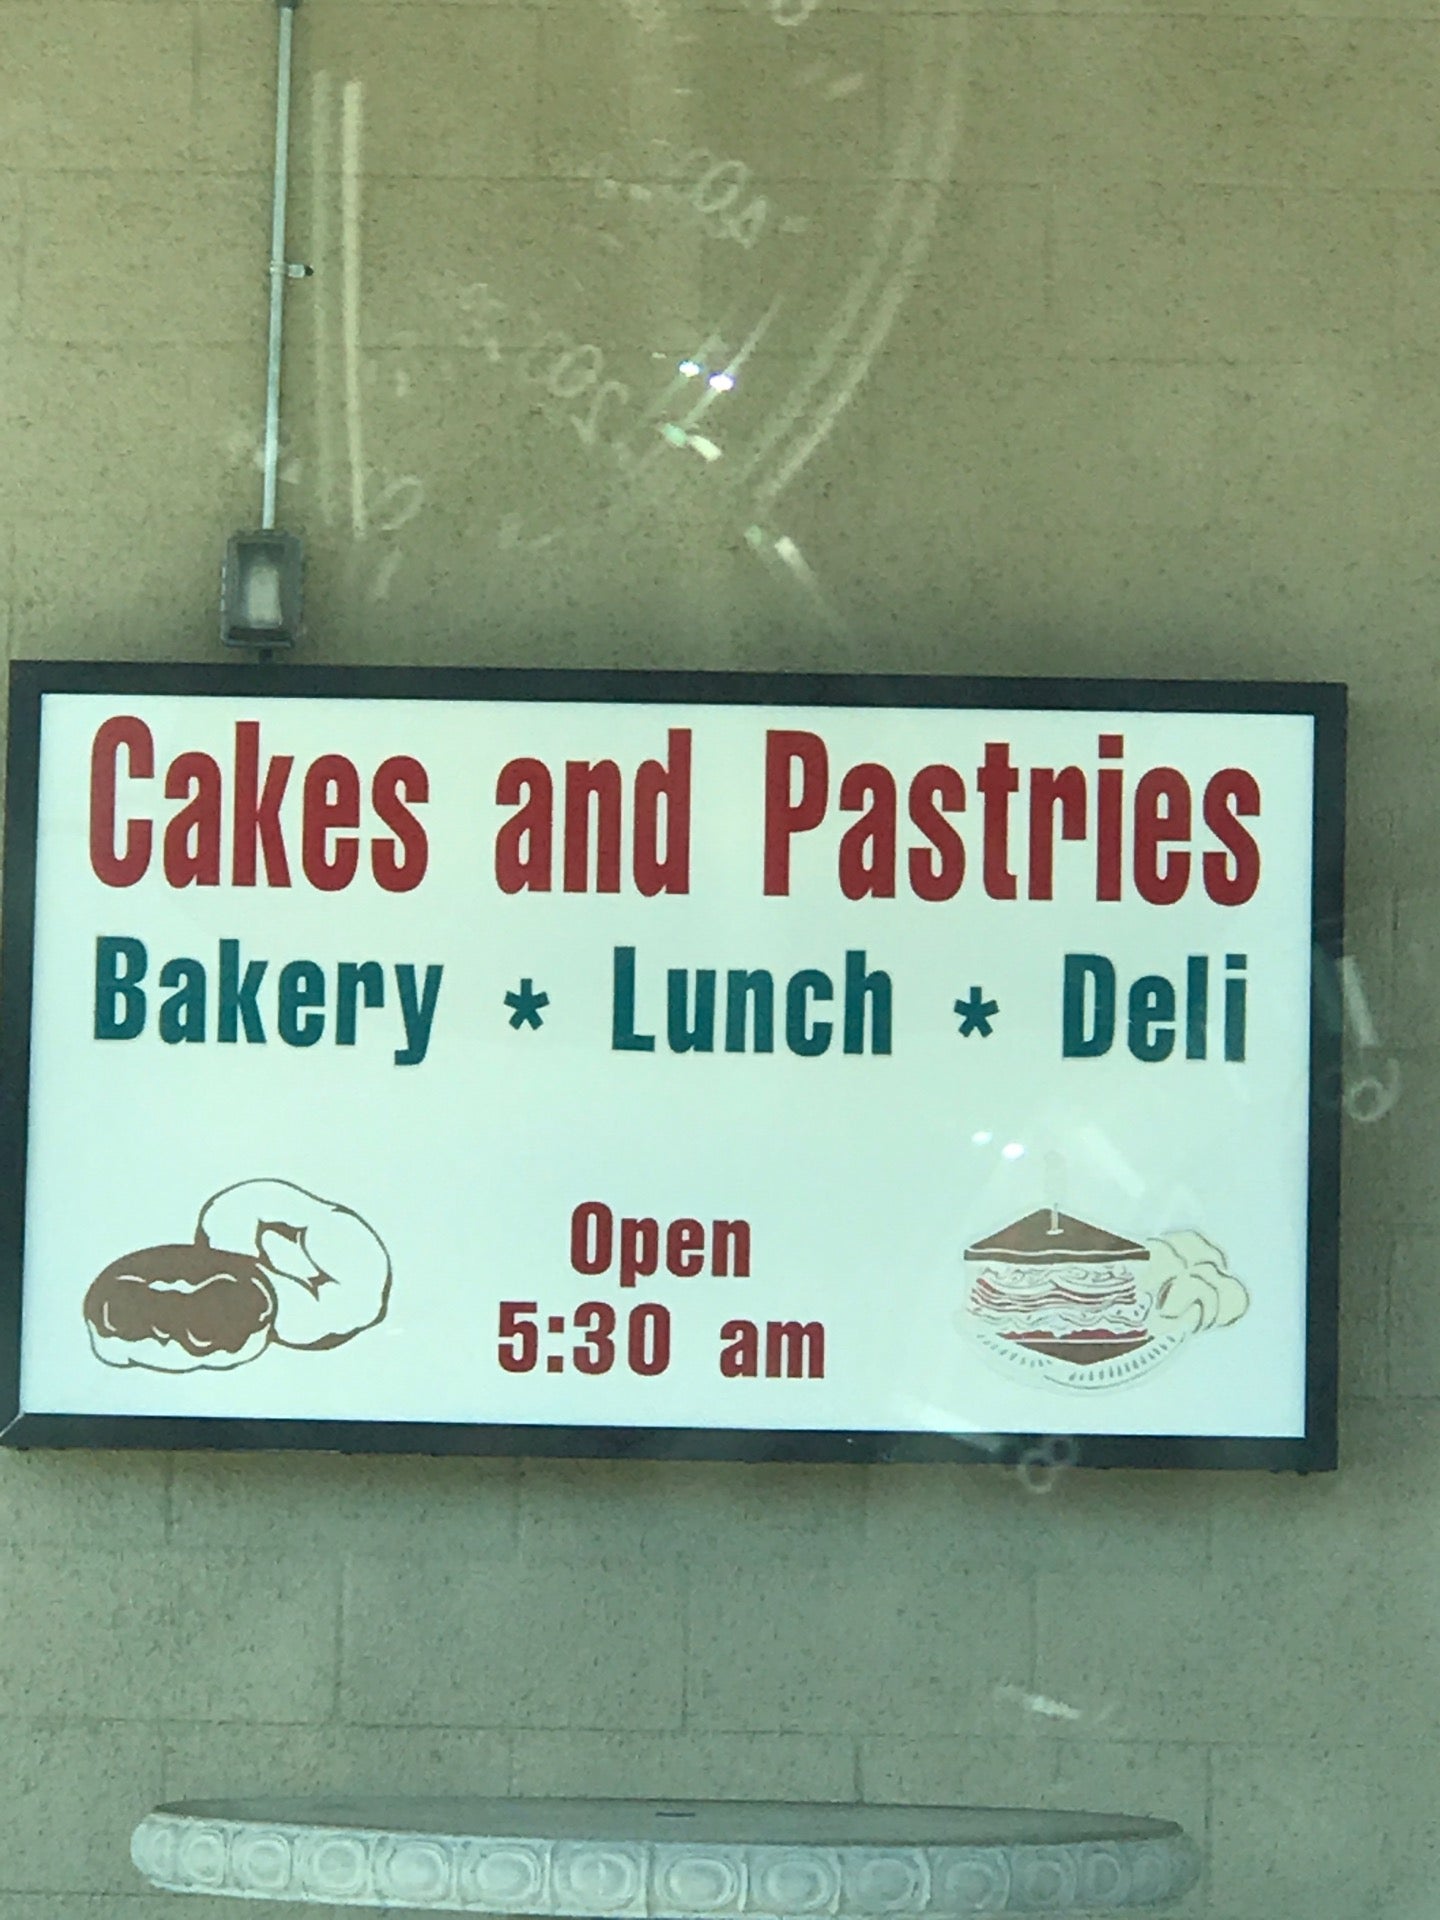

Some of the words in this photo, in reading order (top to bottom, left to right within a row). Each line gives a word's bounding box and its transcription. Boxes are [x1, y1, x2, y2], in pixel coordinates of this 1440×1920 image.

[90, 716, 430, 894] Cakes
[495, 728, 693, 898] and
[763, 729, 1261, 908] Pastries
[94, 935, 443, 1067] Bakery
[612, 945, 893, 1060] Lunch
[1062, 953, 1248, 1064] Deli
[570, 1201, 752, 1289] Open
[497, 1300, 671, 1377] 5:30
[719, 1319, 825, 1380] am
